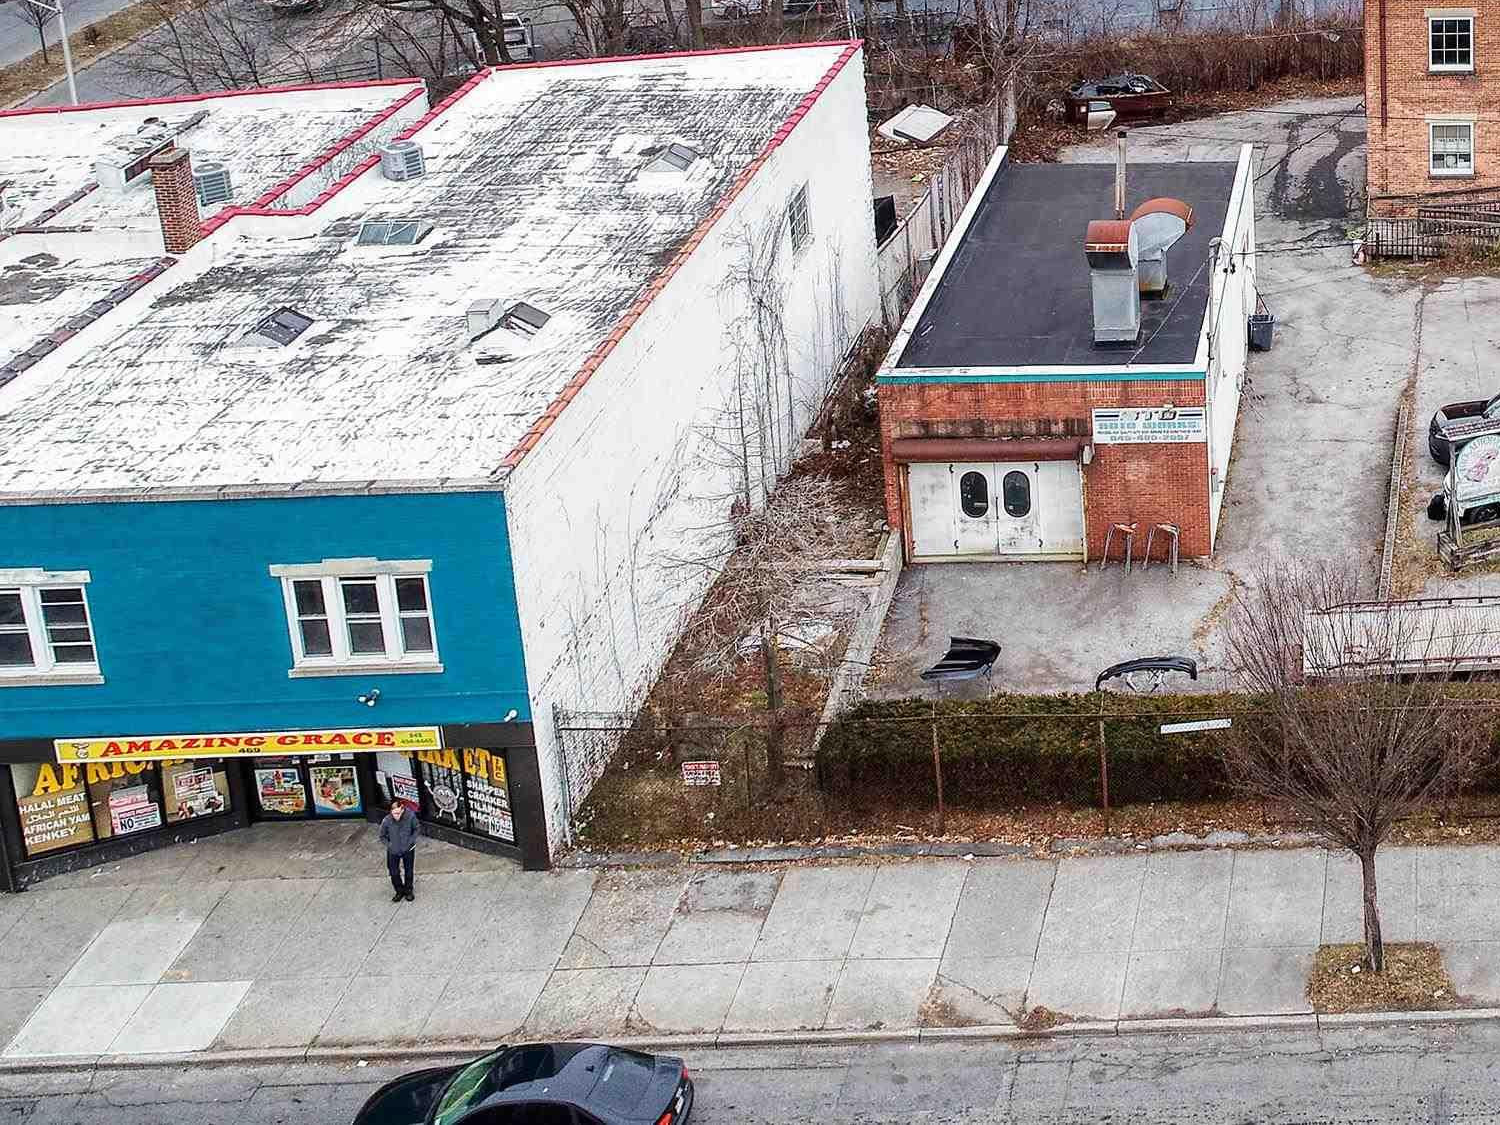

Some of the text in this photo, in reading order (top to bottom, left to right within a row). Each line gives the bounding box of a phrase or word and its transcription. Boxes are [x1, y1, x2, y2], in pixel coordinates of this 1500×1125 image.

[100, 732, 396, 757] AMAZING GRACE
[19, 793, 87, 814] HALAL MEAT
[467, 790, 509, 809] CROAKER
[24, 813, 91, 835] AFRICAN YAM
[120, 818, 135, 832] NO
[25, 827, 77, 845] KENKEY
